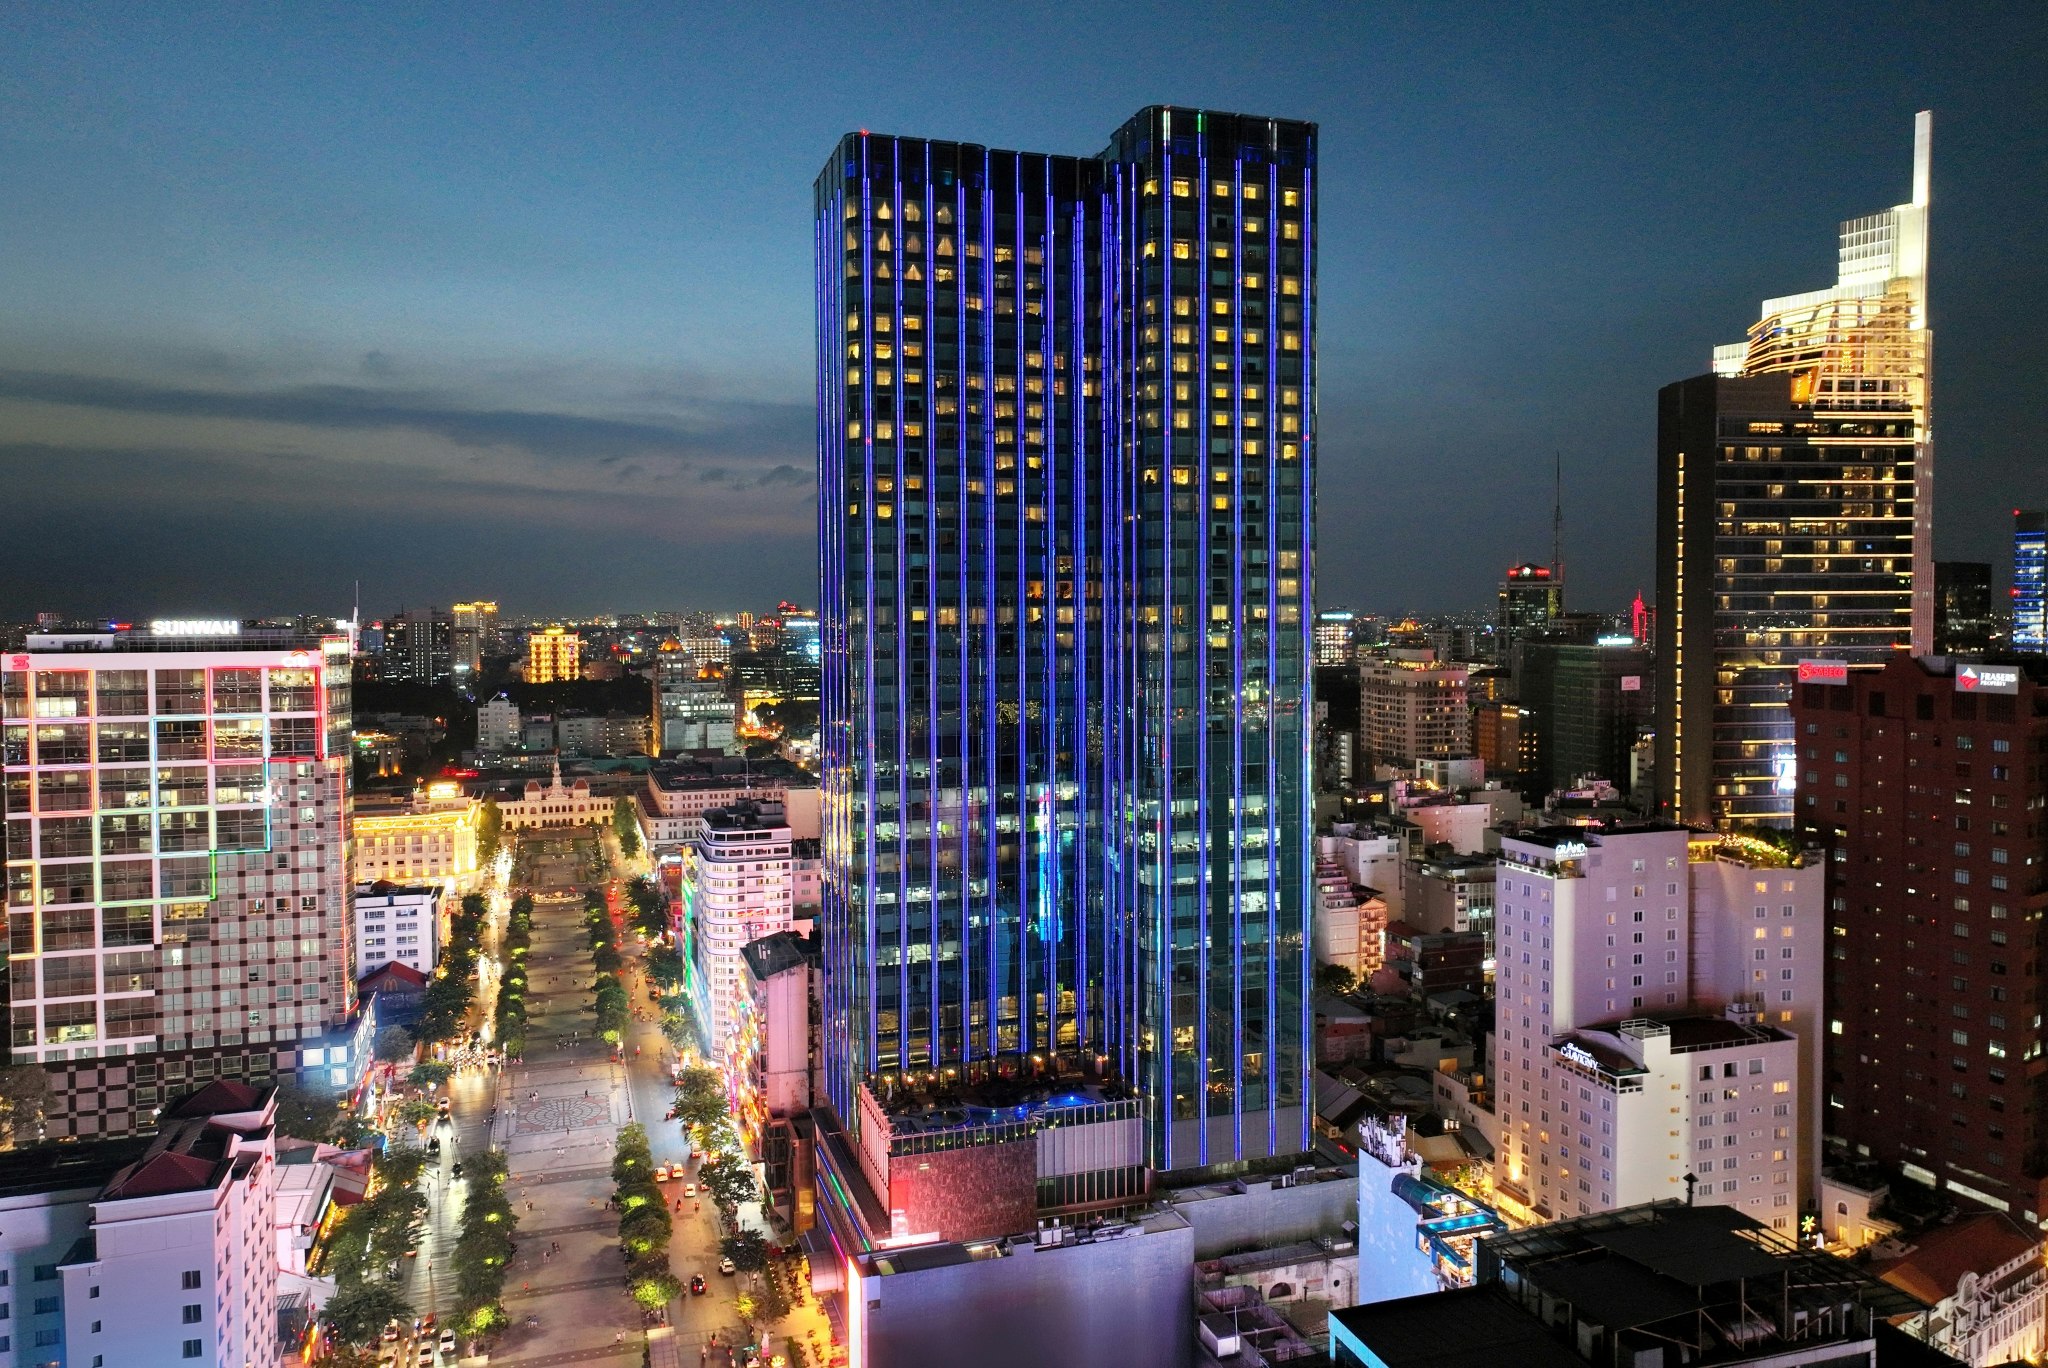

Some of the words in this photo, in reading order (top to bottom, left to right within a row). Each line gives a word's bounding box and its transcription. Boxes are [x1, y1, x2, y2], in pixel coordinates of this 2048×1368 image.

[151, 620, 238, 635] SUNWAH
[1813, 667, 1845, 677] SABECO
[1980, 672, 2017, 682] FRASERS
[1556, 841, 1585, 854] GRAND
